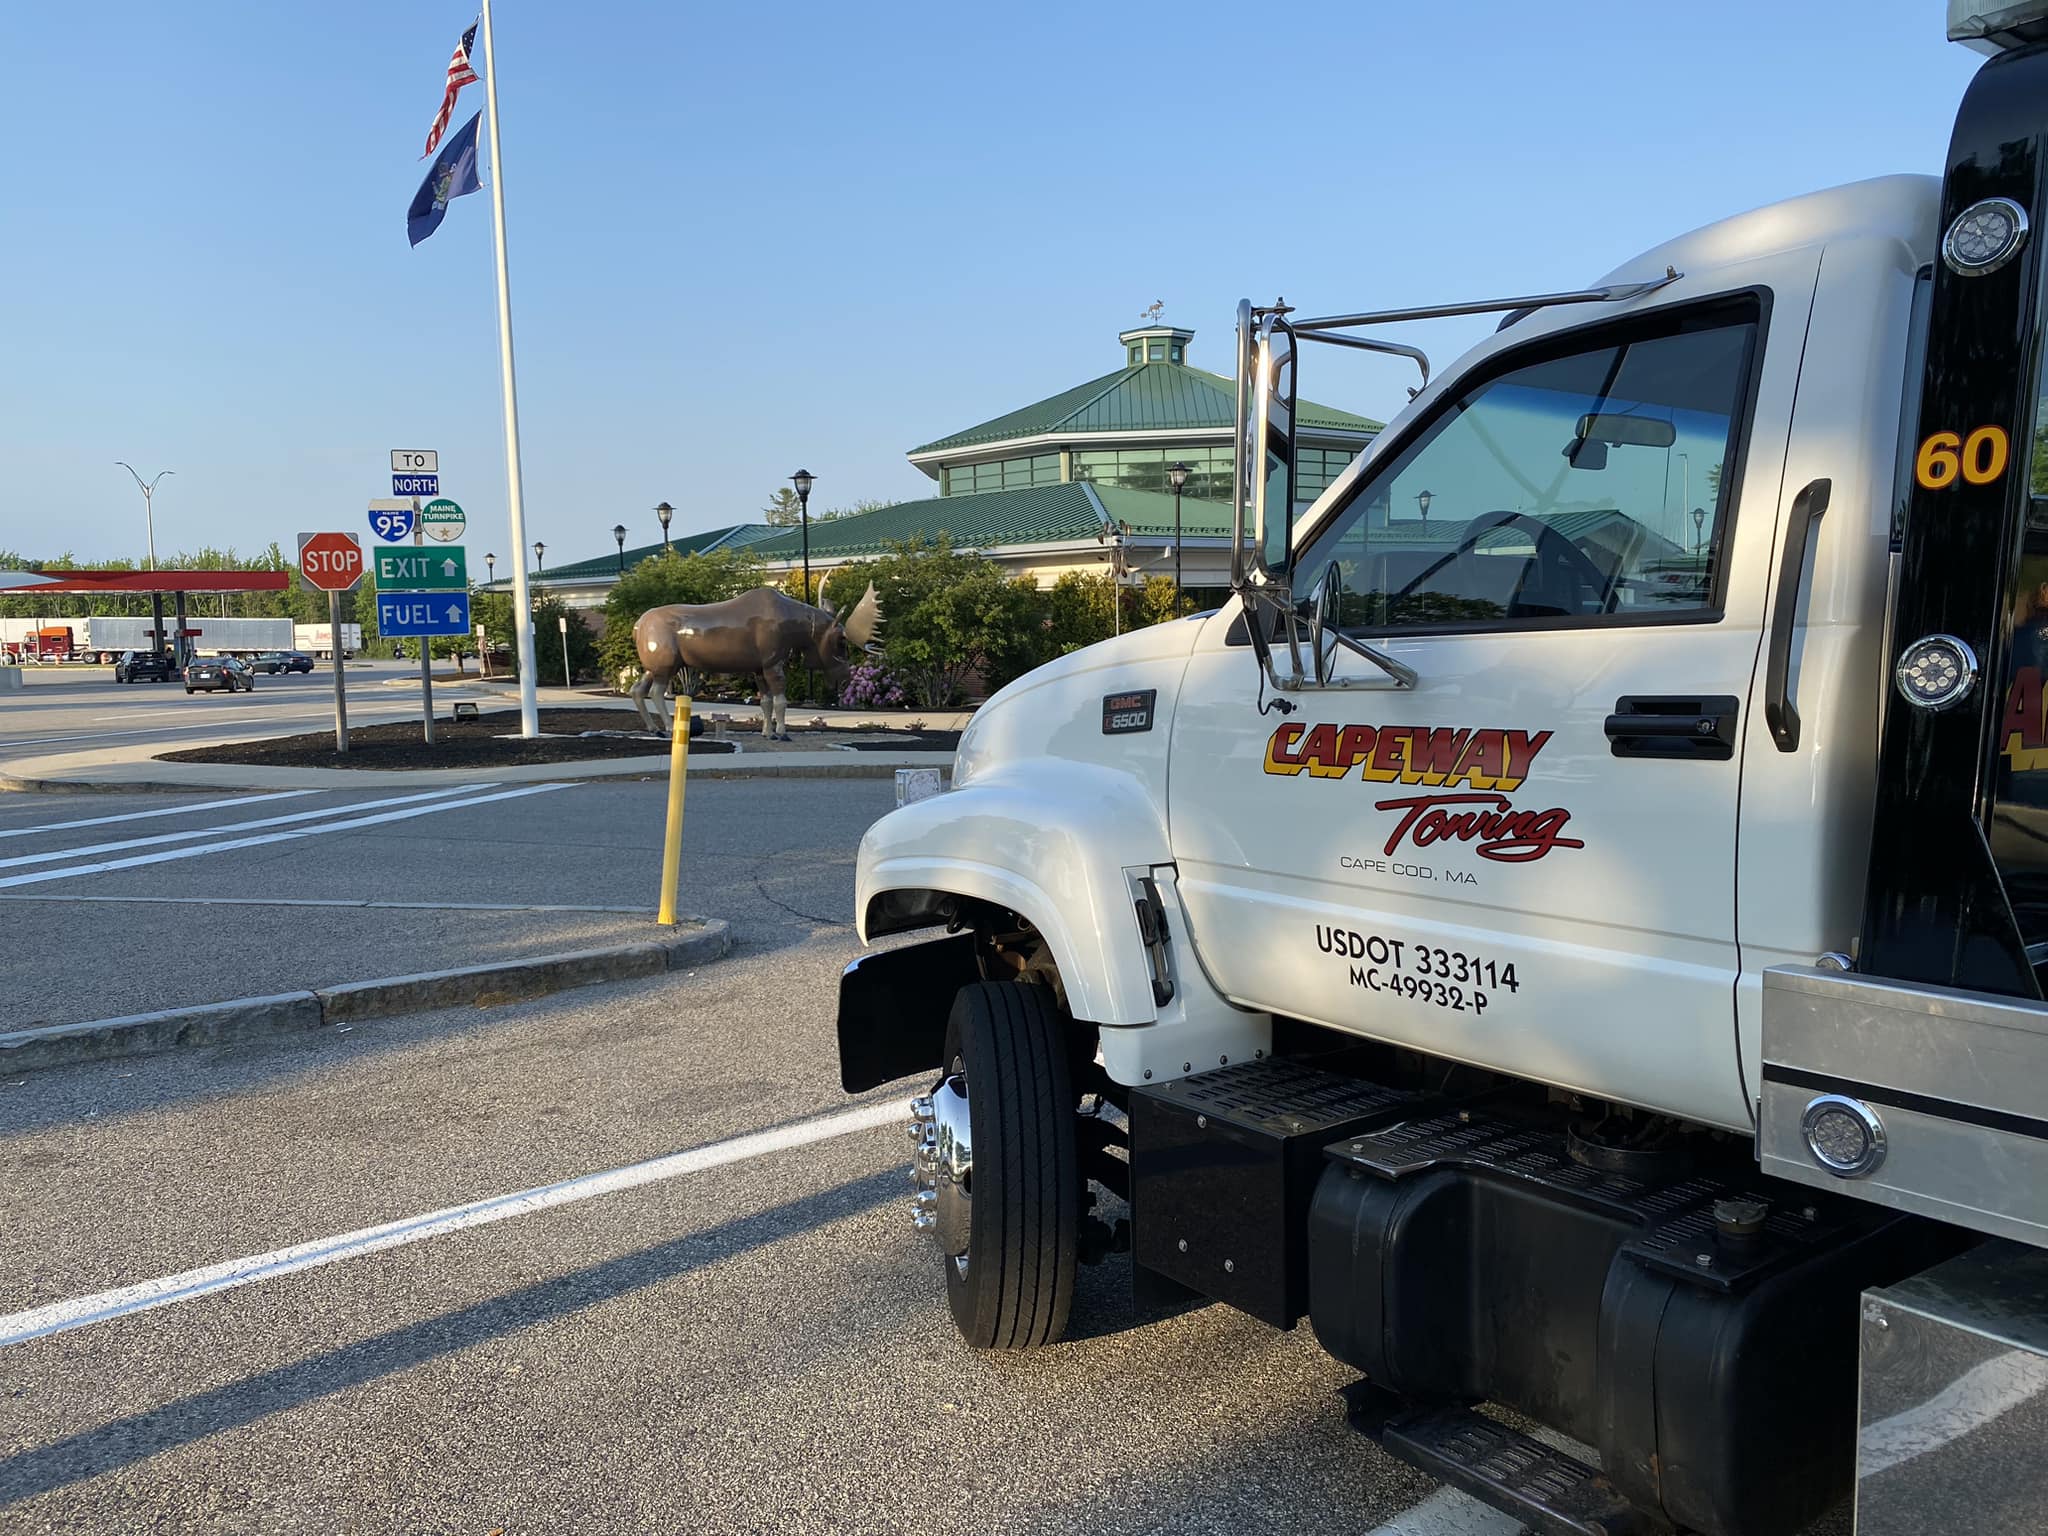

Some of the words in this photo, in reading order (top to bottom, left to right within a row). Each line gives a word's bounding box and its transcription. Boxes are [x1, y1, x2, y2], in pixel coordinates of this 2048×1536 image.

[403, 454, 425, 467] TO
[1915, 424, 2009, 490] 60
[394, 479, 437, 492] NORTH
[376, 516, 407, 537] 95
[306, 550, 358, 572] STOP
[381, 558, 430, 578] EXIT
[382, 604, 439, 625] FUEL
[1110, 695, 1142, 710] GMC
[1264, 722, 1554, 792] CAPEWAY
[1375, 793, 1585, 863] Towing
[1340, 856, 1386, 873] CAPE
[1446, 870, 1478, 886] MA
[1316, 924, 1405, 969] USDOT
[1414, 944, 1520, 994] 333114
[1350, 964, 1488, 1016] MC-49932-P
